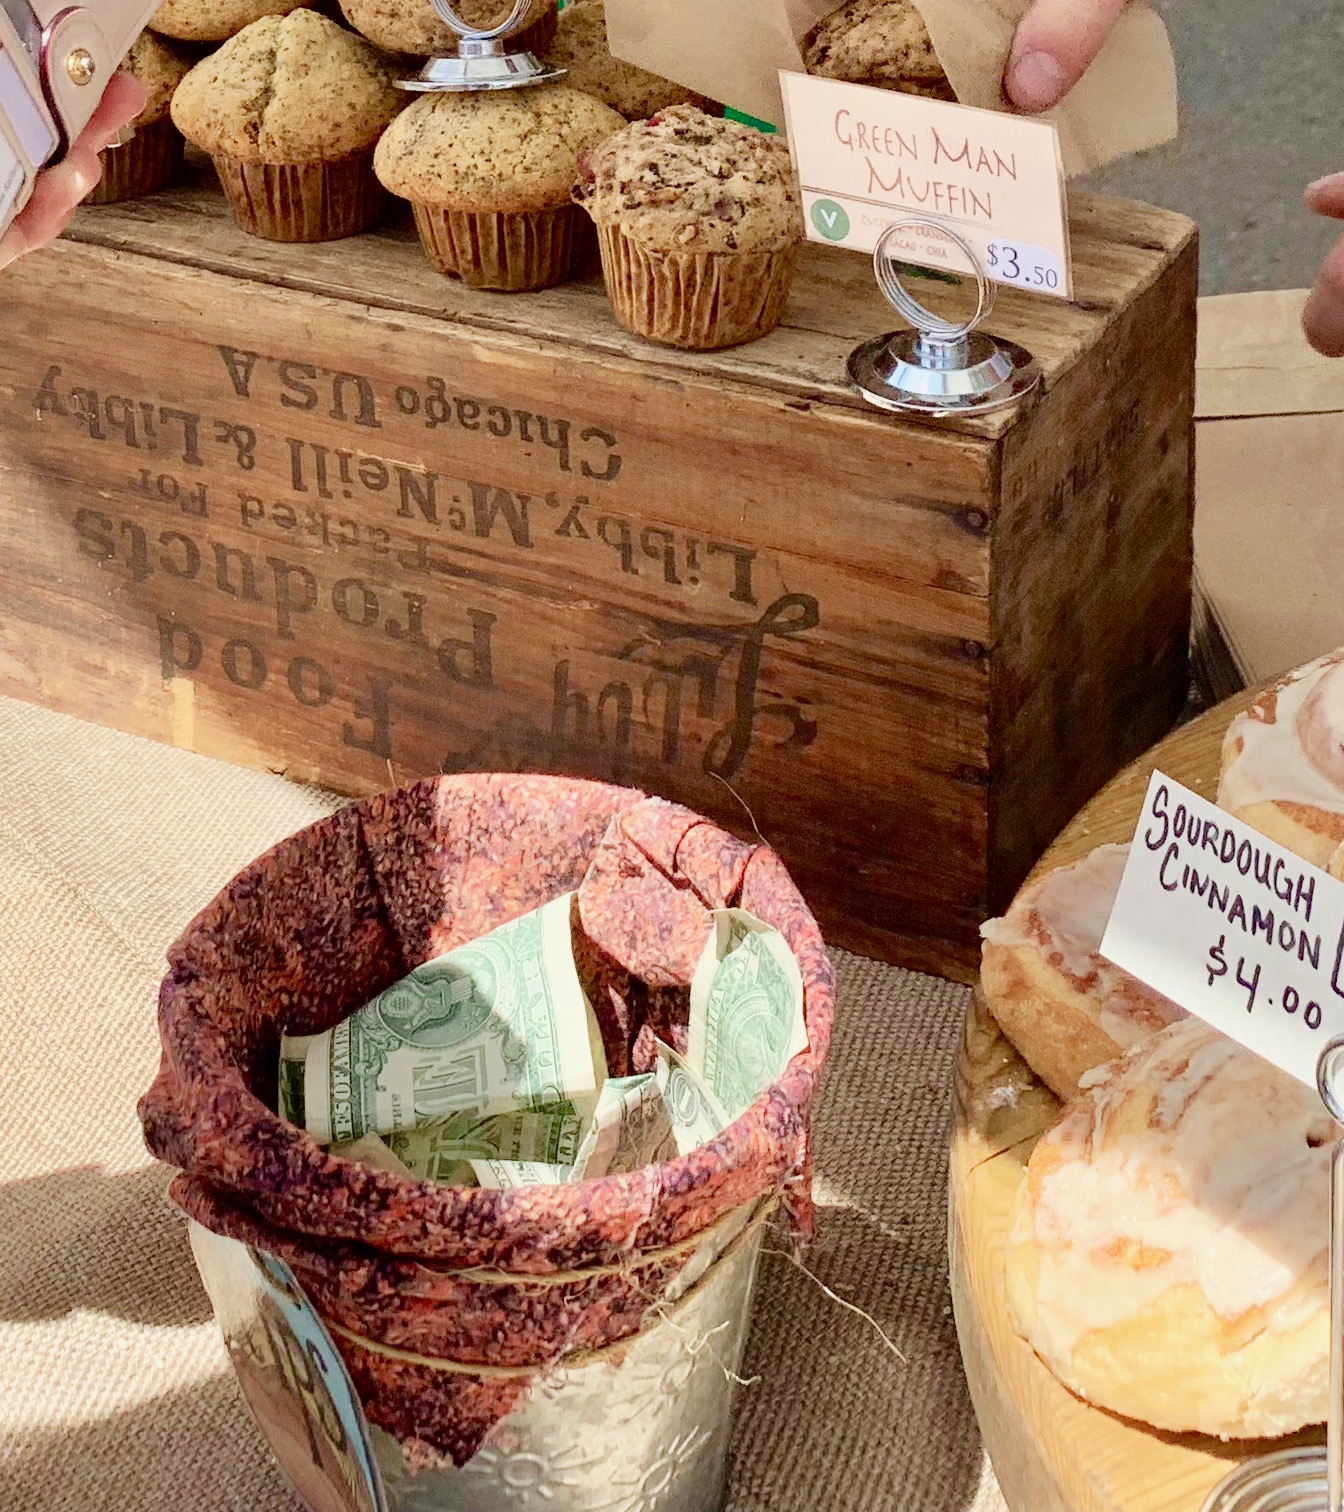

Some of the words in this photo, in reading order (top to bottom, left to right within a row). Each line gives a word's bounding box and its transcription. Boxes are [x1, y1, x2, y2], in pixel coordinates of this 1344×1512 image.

[834, 109, 918, 160] GREEN
[930, 125, 1017, 181] MAN
[864, 156, 992, 219] MUFFIN
[926, 245, 948, 259] CHIA
[986, 243, 1058, 289] $3.50
[32, 364, 205, 468] Libby
[213, 417, 257, 471] &
[395, 376, 623, 482] Chicago
[126, 467, 208, 518] For
[237, 492, 432, 575] Packed
[72, 507, 498, 687] Products
[158, 614, 393, 760] Food
[1145, 784, 1316, 923] SOURDOUGH
[1158, 841, 1322, 970] CINNAMON
[1206, 934, 1322, 1030] $4.00
